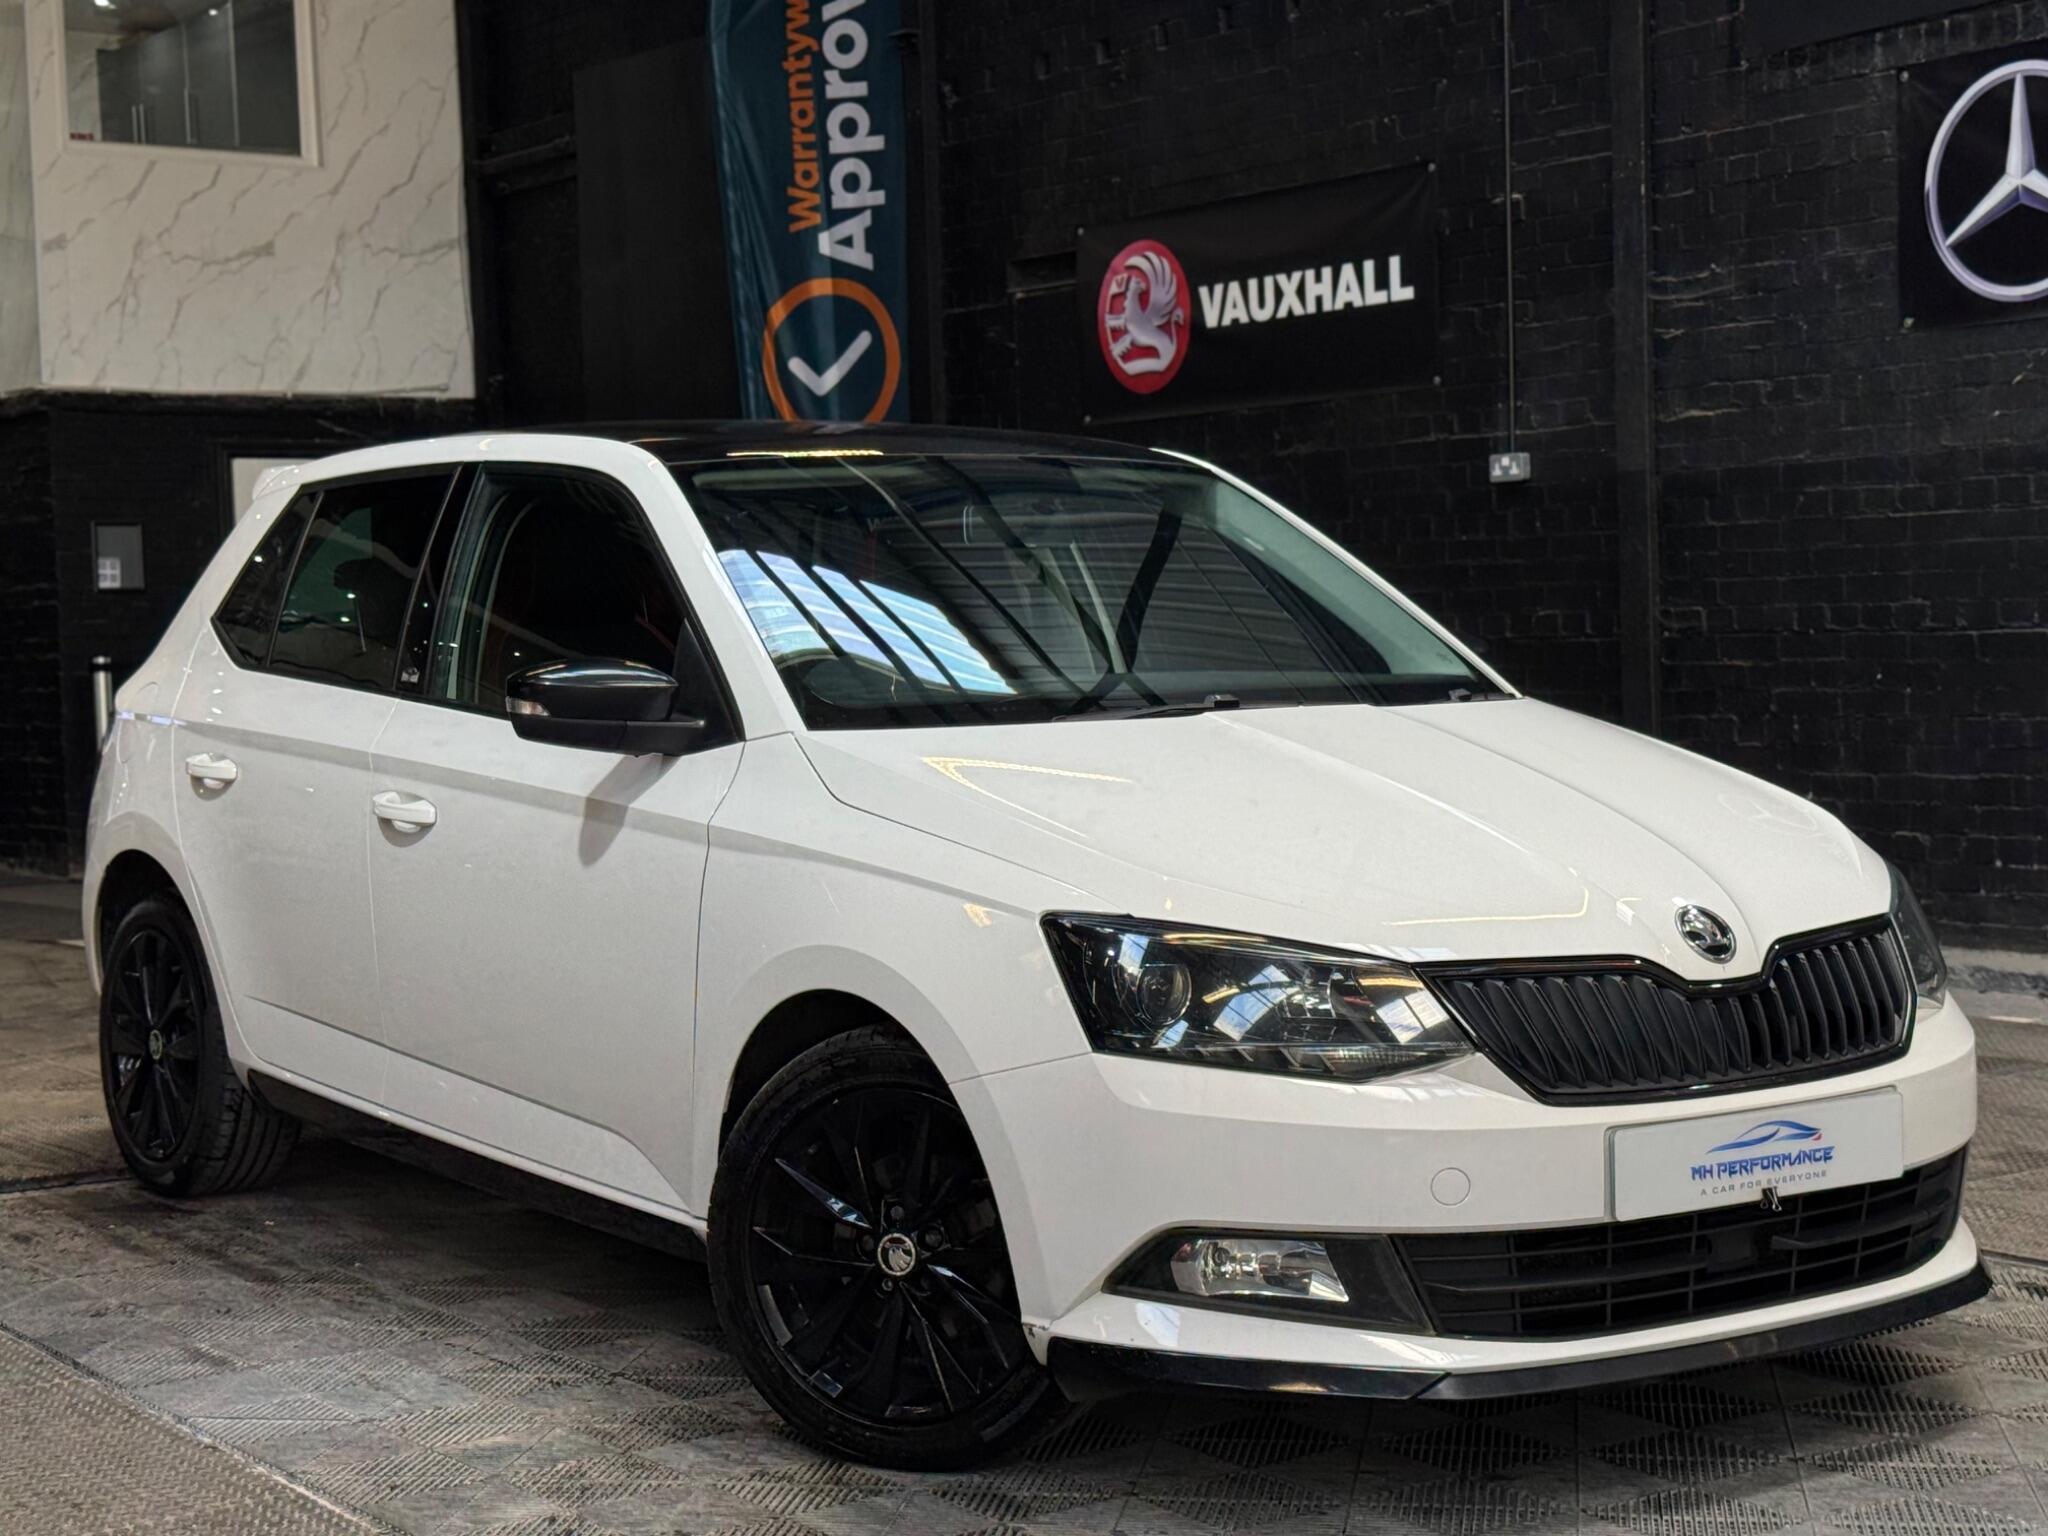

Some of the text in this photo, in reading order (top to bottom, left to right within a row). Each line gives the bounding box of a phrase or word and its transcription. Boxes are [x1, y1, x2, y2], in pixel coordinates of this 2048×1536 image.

[1198, 255, 1415, 329] VAUXHALL
[1690, 1146, 1836, 1181] MH PERFORMANCE
[1700, 1169, 1828, 1197] A CAR FOR EVERYONE
